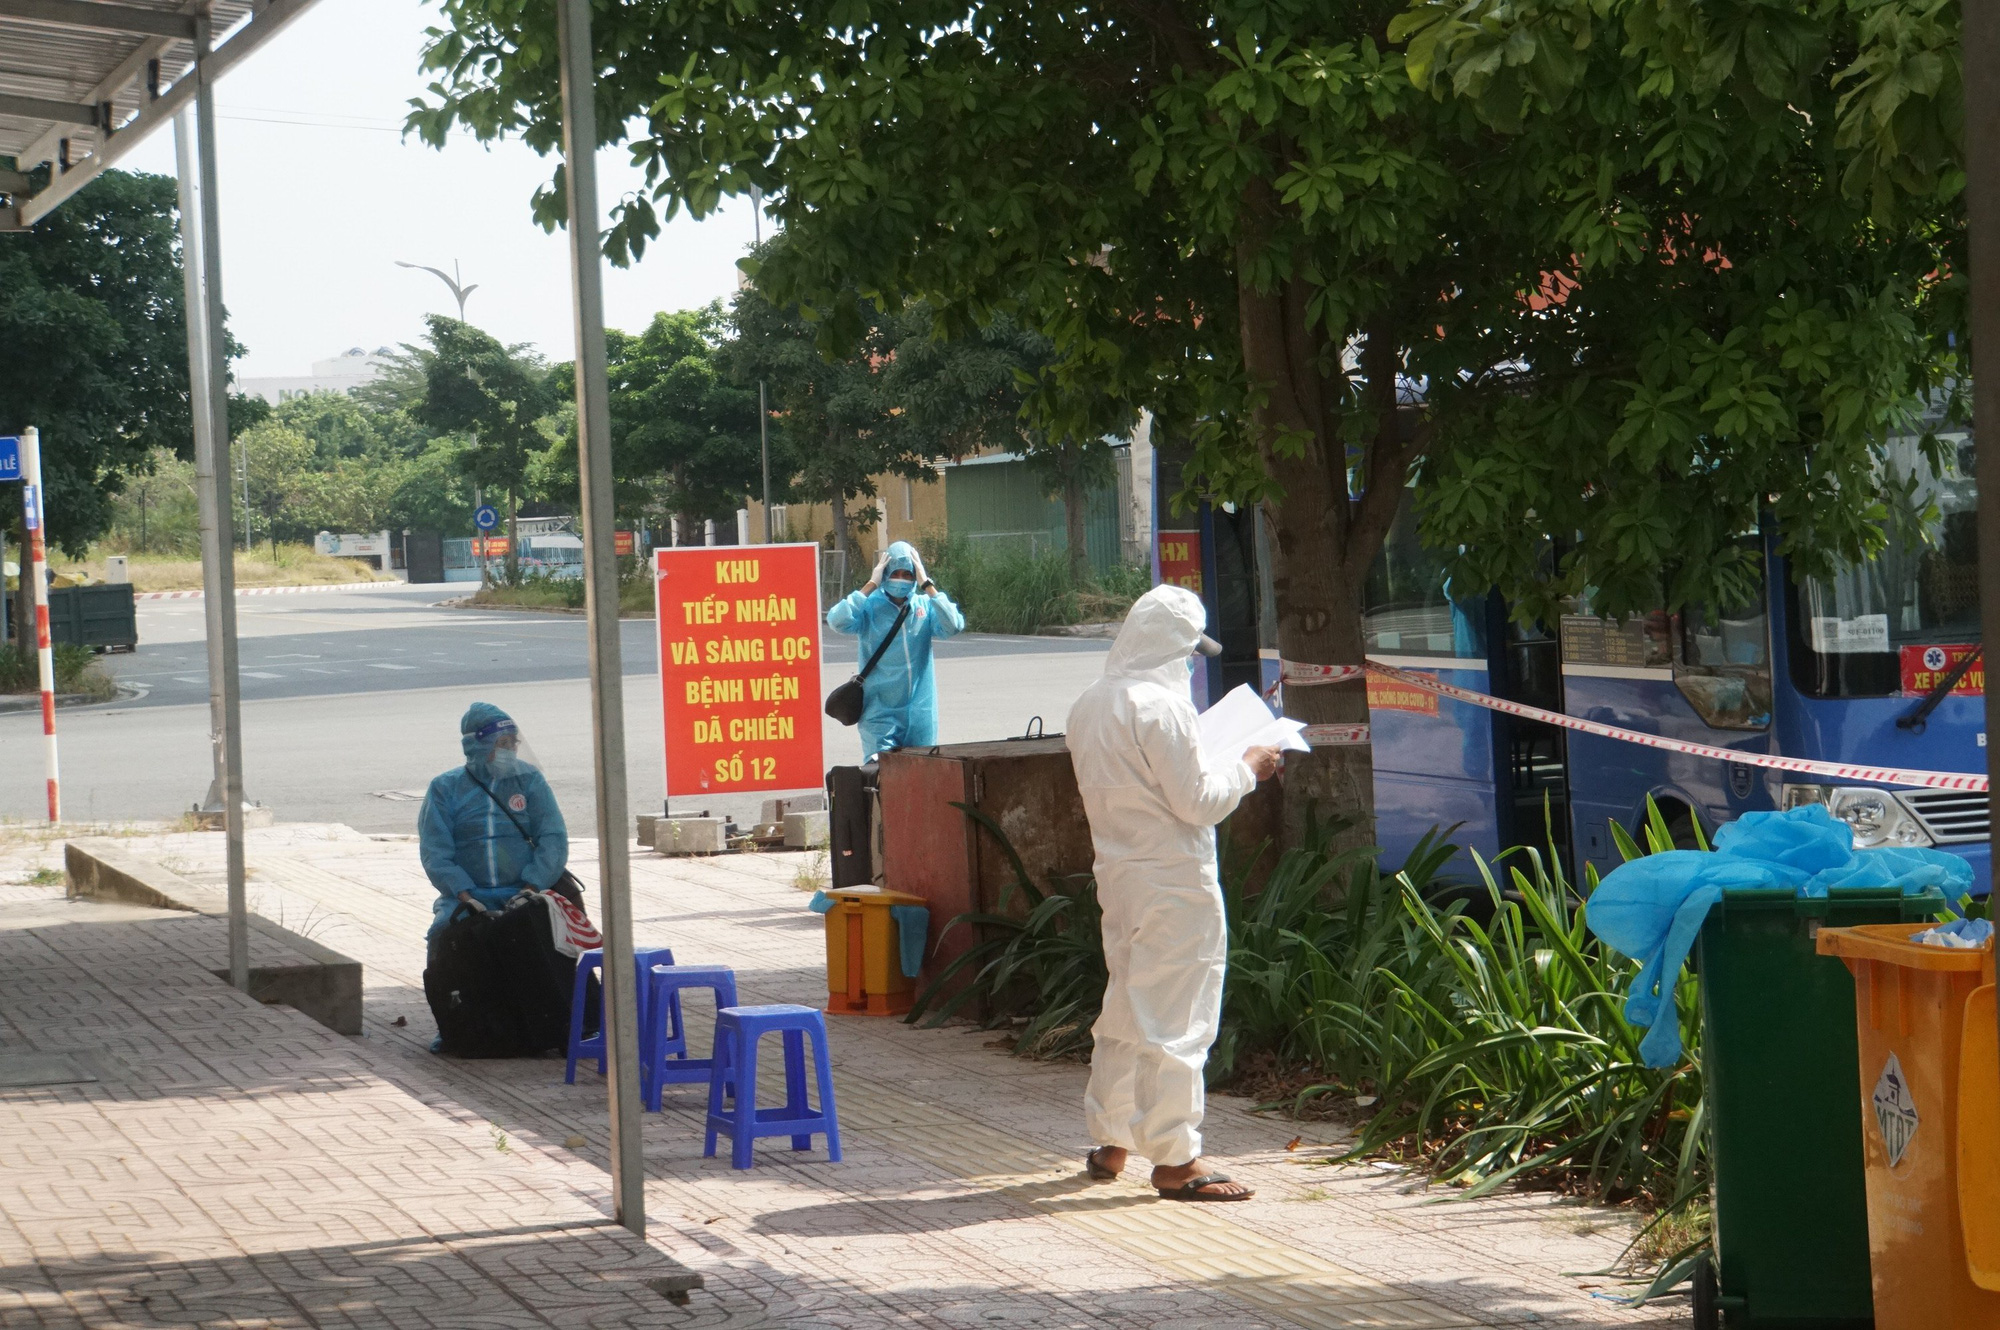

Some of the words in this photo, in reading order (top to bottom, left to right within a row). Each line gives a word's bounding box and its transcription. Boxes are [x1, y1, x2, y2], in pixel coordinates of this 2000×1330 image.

[716, 560, 759, 584] KHU
[683, 593, 729, 625] TIẾP
[736, 594, 796, 626] NHẬN
[671, 637, 699, 665] VÀ
[706, 635, 765, 664] SÀNG
[771, 637, 811, 665] LỌC
[686, 676, 744, 709] BỆNH
[750, 673, 799, 706] VIỆN
[1914, 672, 1930, 689] XE
[1934, 672, 1967, 693] PC
[1410, 692, 1424, 707] COVID
[694, 715, 723, 744] DÃ
[729, 710, 794, 742] CHIẾN
[715, 751, 744, 783] SỐ
[750, 757, 777, 780] 12
